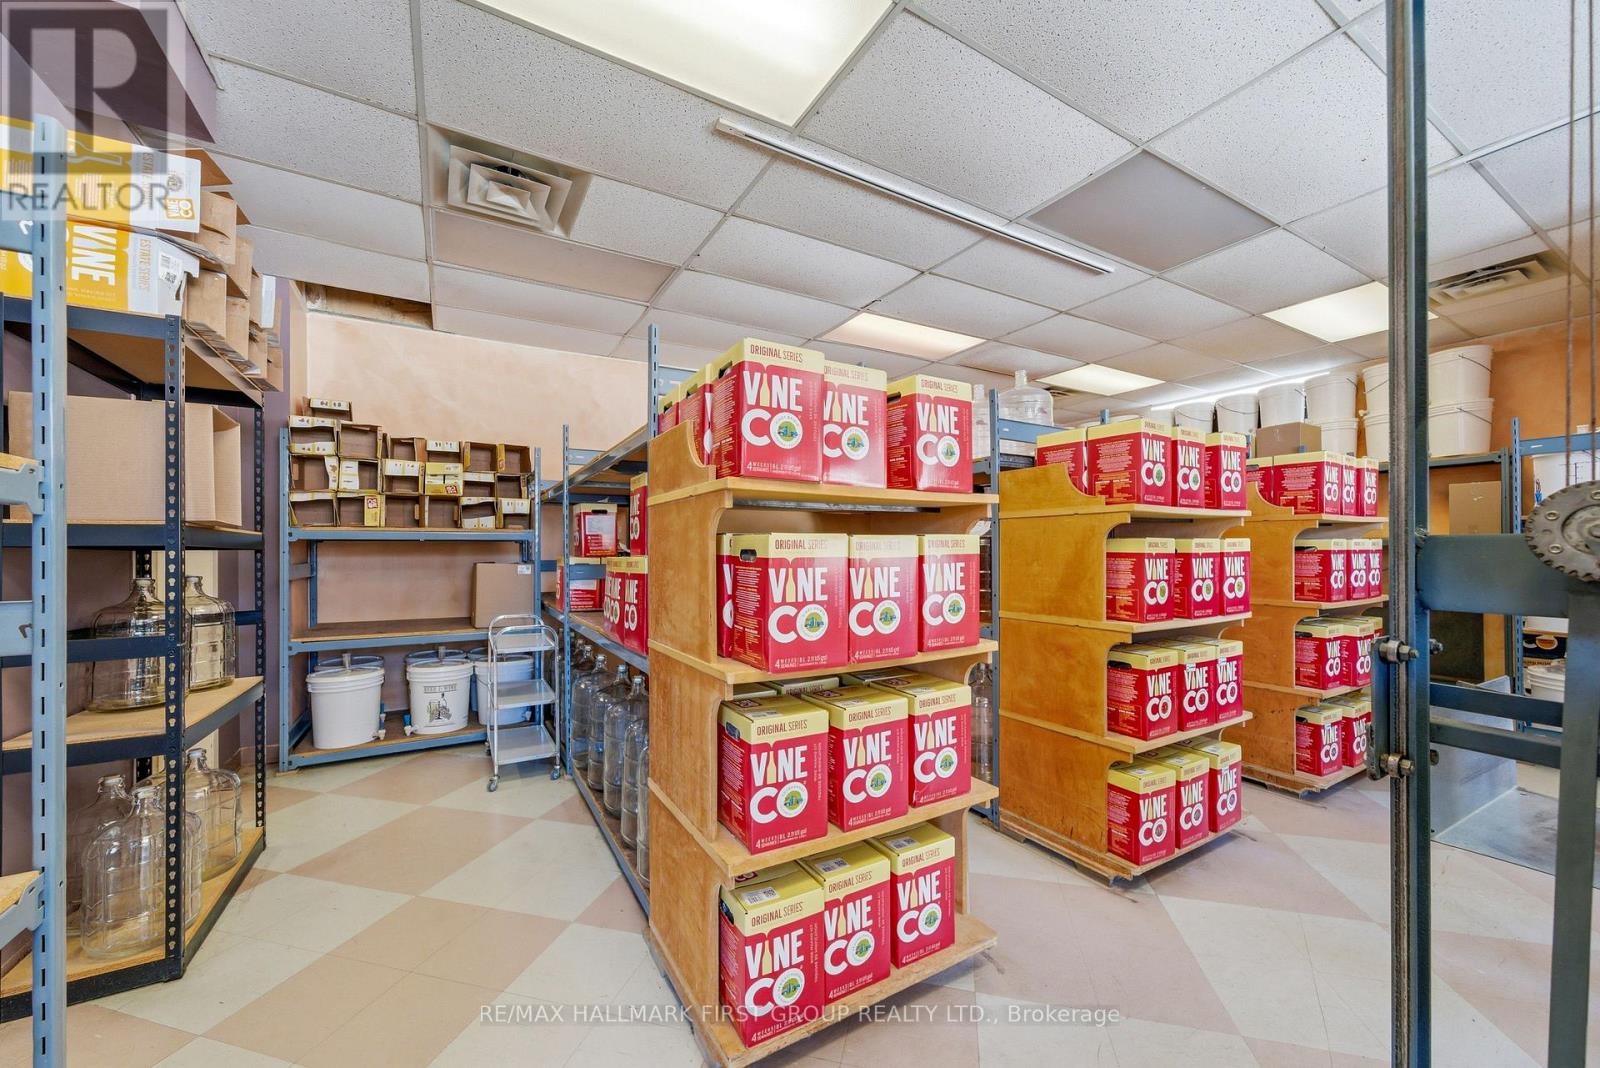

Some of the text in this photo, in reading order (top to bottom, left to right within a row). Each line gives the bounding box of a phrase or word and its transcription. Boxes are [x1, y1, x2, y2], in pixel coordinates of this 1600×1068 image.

[179, 200, 192, 218] CO
[71, 225, 118, 286] VINE
[750, 344, 804, 364] ORIGINAL SERIES
[743, 370, 803, 412] VINE
[920, 378, 942, 390] ORIGINAL
[824, 391, 869, 426] VINE
[917, 401, 959, 435] VINE
[741, 408, 804, 450] CO
[823, 424, 870, 460] CO
[917, 434, 960, 468] CO
[1142, 438, 1165, 462] VINE
[747, 462, 752, 471] 4
[1178, 445, 1200, 467] VINE
[1221, 450, 1241, 471] VINE
[1140, 463, 1166, 487] CO
[1177, 467, 1200, 491] CO
[1220, 471, 1242, 493] CO
[1324, 483, 1339, 501] CO
[1343, 486, 1356, 503] CO
[1365, 487, 1376, 504] CO
[775, 539, 828, 550] ORIGINAL SERIES
[855, 541, 882, 552] ORIGINAL
[928, 540, 949, 548] ORIGINAL
[1144, 558, 1168, 580] VINE
[1192, 558, 1214, 579] VINE
[1224, 556, 1245, 576] VINE
[1352, 553, 1366, 570] VINE
[769, 567, 828, 603] VINE
[850, 567, 901, 599] VINE
[923, 562, 965, 592] VINE
[1223, 576, 1245, 599] CO
[1330, 570, 1345, 589] CO
[1350, 570, 1366, 587] CO
[1369, 569, 1380, 586] CO
[1144, 580, 1169, 605] CO
[1191, 578, 1214, 602] CO
[849, 600, 901, 636] CO
[922, 593, 966, 626] CO
[768, 604, 829, 644] CO
[854, 651, 859, 659] 4
[1326, 640, 1341, 658] VINE
[775, 659, 780, 669] 4
[1216, 661, 1237, 683] VINE
[1326, 657, 1341, 677] CO
[1356, 655, 1371, 675] CO
[1147, 672, 1172, 697] VINE
[1184, 667, 1208, 690] VINE
[919, 698, 941, 708] ORIGINAL
[1183, 688, 1209, 714] CO
[1216, 682, 1238, 706] CO
[848, 706, 892, 722] ORIGINAL SERIES
[1146, 695, 1172, 722] CO
[757, 719, 808, 736] ORIGINAL SERIES
[914, 716, 957, 751] VINE
[843, 730, 892, 769] VINE
[1320, 743, 1339, 763] CO
[1353, 734, 1367, 755] CO
[750, 746, 807, 787] VINE
[913, 747, 958, 783] CO
[842, 764, 893, 803] CO
[1217, 768, 1237, 794] VINE
[750, 782, 809, 824] CO
[1181, 780, 1203, 807] VINE
[1217, 790, 1237, 816] CO
[1139, 794, 1167, 822] VINE
[1180, 803, 1204, 830] CO
[848, 817, 853, 826] 4
[1138, 818, 1168, 846] CO
[756, 839, 761, 849] 4
[902, 848, 940, 868] ORIGINAL SERIES
[828, 871, 872, 893] ORIGINAL SERIES
[897, 870, 941, 911] VINE
[751, 902, 804, 927] ORIGINAL SERIES
[824, 895, 873, 941] VINE
[896, 902, 942, 943] CO
[745, 928, 804, 979] VINE
[824, 930, 875, 976] CO
[902, 955, 906, 964] 4
[744, 968, 805, 1016] CO
[828, 990, 834, 999] 4
[752, 1032, 757, 1042] 4
